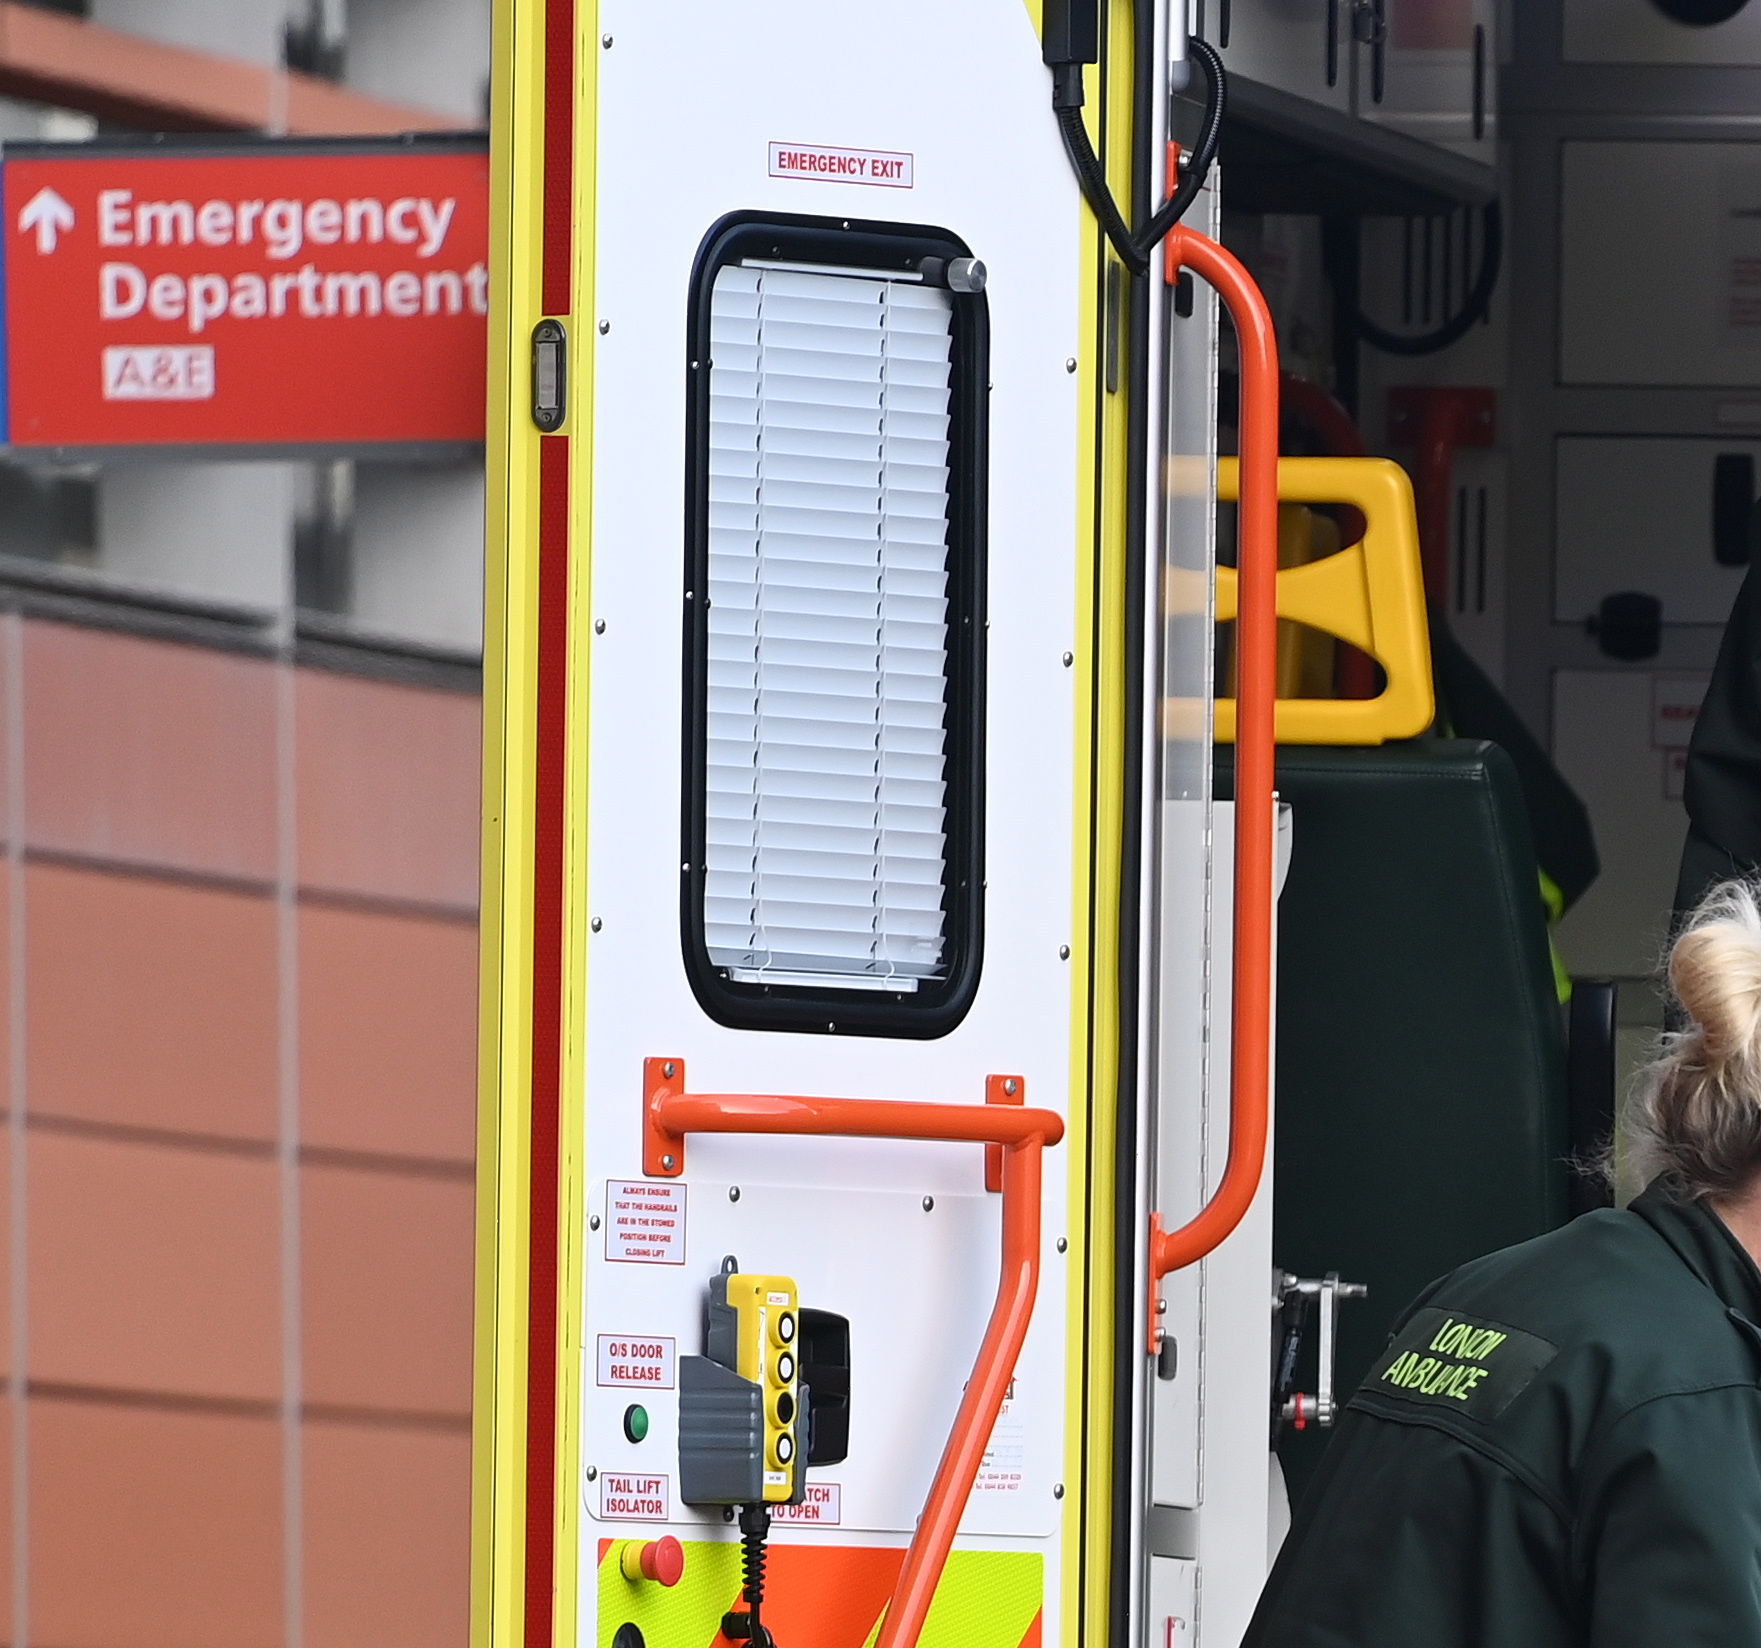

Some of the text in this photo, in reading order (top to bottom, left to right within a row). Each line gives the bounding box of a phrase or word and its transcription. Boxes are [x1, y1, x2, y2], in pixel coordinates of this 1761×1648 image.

[778, 151, 904, 179] EMERGENCY EXIT
[98, 188, 457, 260] Emergency
[98, 260, 489, 334] Department
[112, 353, 212, 389] A&E
[615, 1201, 630, 1210] THAT
[631, 1202, 643, 1210] THE
[625, 1247, 665, 1258] CLOSING LIFT
[1428, 1317, 1508, 1361] LONON
[609, 1342, 663, 1359] O/S DOOR
[610, 1364, 662, 1381] RELEASE
[607, 1478, 661, 1495] TAIL LIFT
[806, 1487, 831, 1502] TCH
[606, 1498, 663, 1515] ISOLATOR
[771, 1504, 820, 1519] TO OPEN
